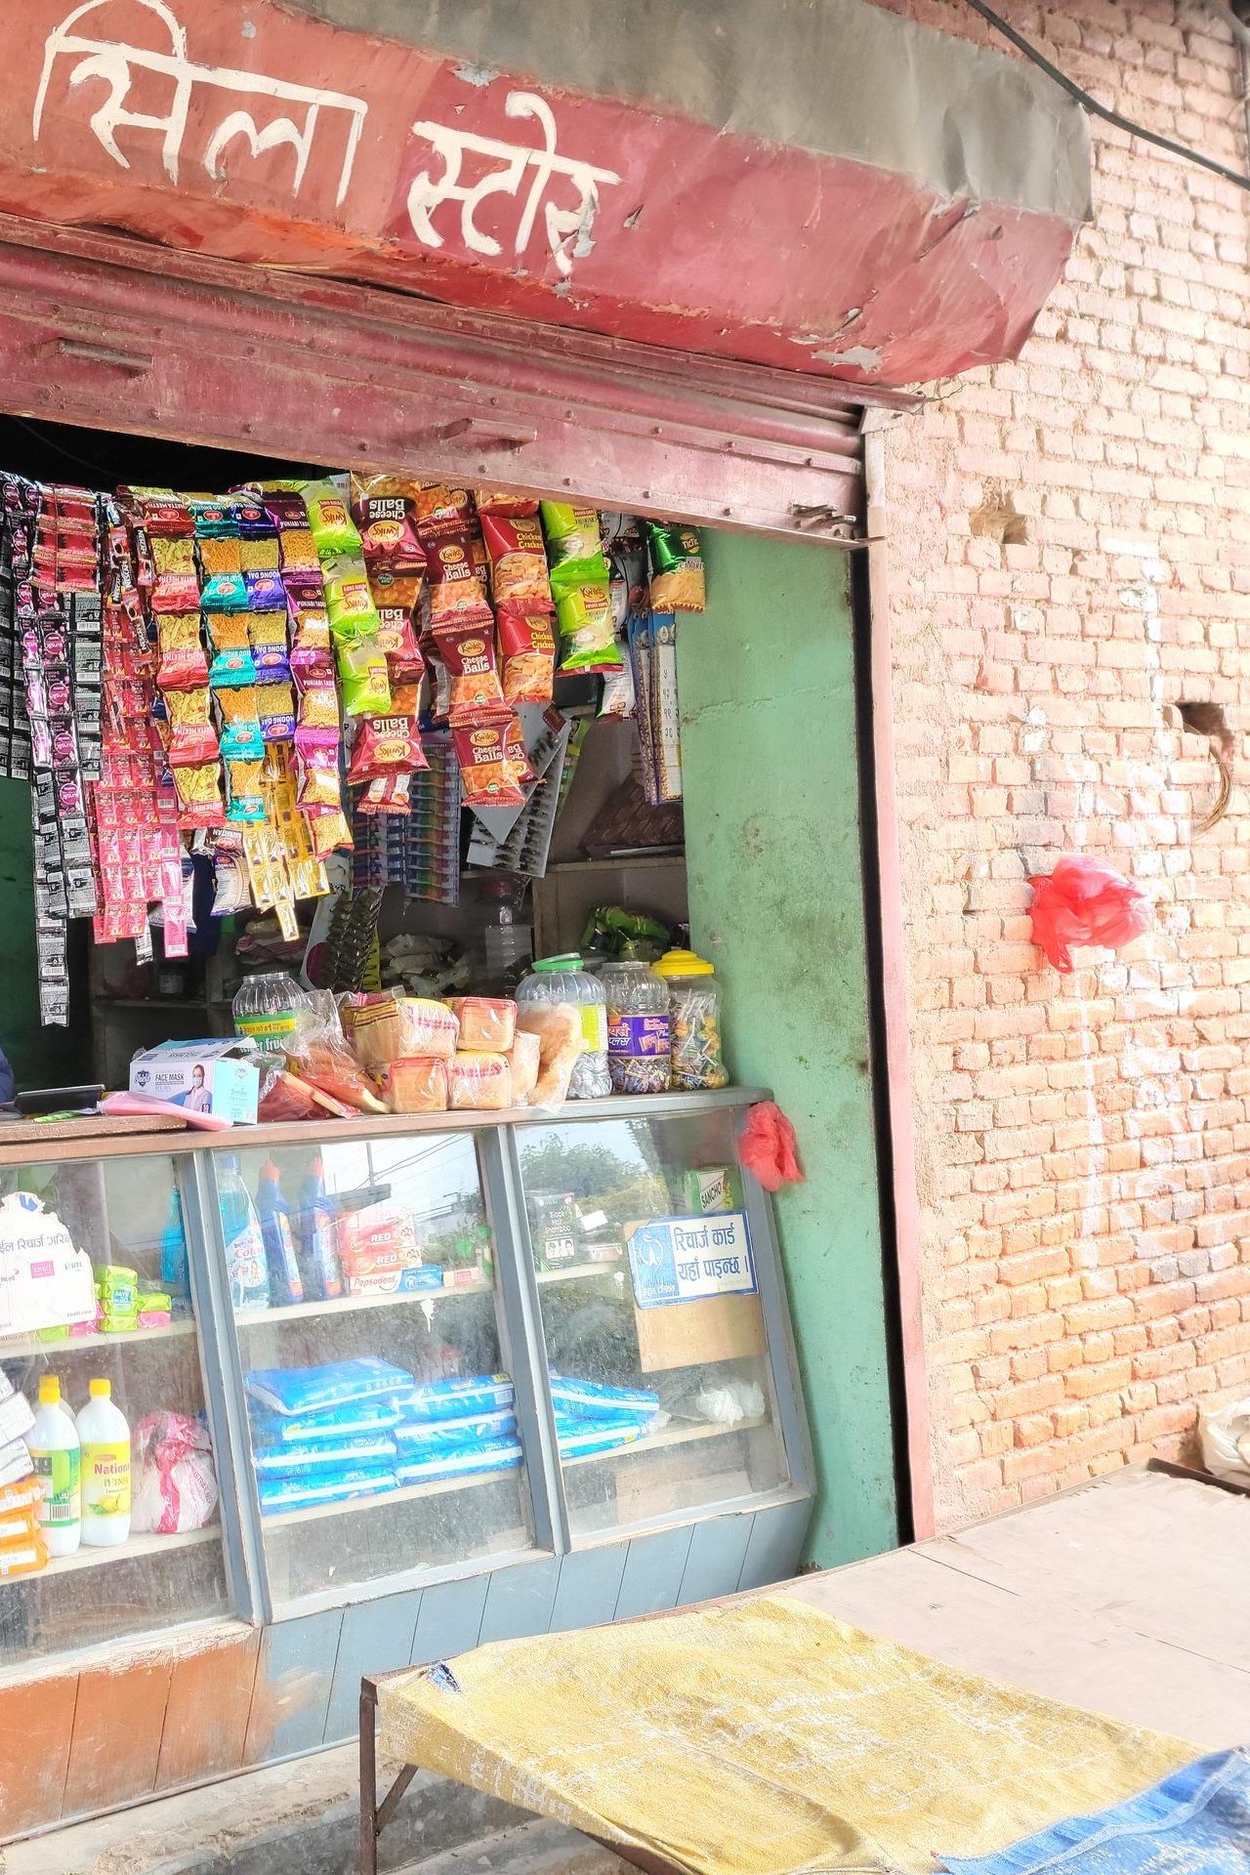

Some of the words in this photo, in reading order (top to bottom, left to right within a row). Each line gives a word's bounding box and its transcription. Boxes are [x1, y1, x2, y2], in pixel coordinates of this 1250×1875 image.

[33, 0, 368, 207] सिला
[406, 92, 624, 278] स्टोर
[369, 499, 406, 511] Balls
[369, 511, 406, 519] Cheese
[443, 562, 469, 572] Cheese
[446, 568, 472, 581] Balls
[461, 656, 489, 665] Cheese
[464, 662, 491, 675] Balls
[473, 745, 502, 755] Cheese
[475, 751, 504, 764] Balls
[154, 1073, 169, 1082] FACE
[169, 1073, 185, 1082] MASK
[700, 1181, 722, 1209] SANCHO
[17, 1233, 45, 1251] रिचार्ज
[370, 1231, 392, 1243] RED
[673, 1224, 710, 1252] रिचार्ज
[711, 1221, 736, 1247] कार्ड
[376, 1254, 398, 1266] RED
[677, 1255, 702, 1282] यहाँ
[702, 1256, 741, 1280] पाइन्छ
